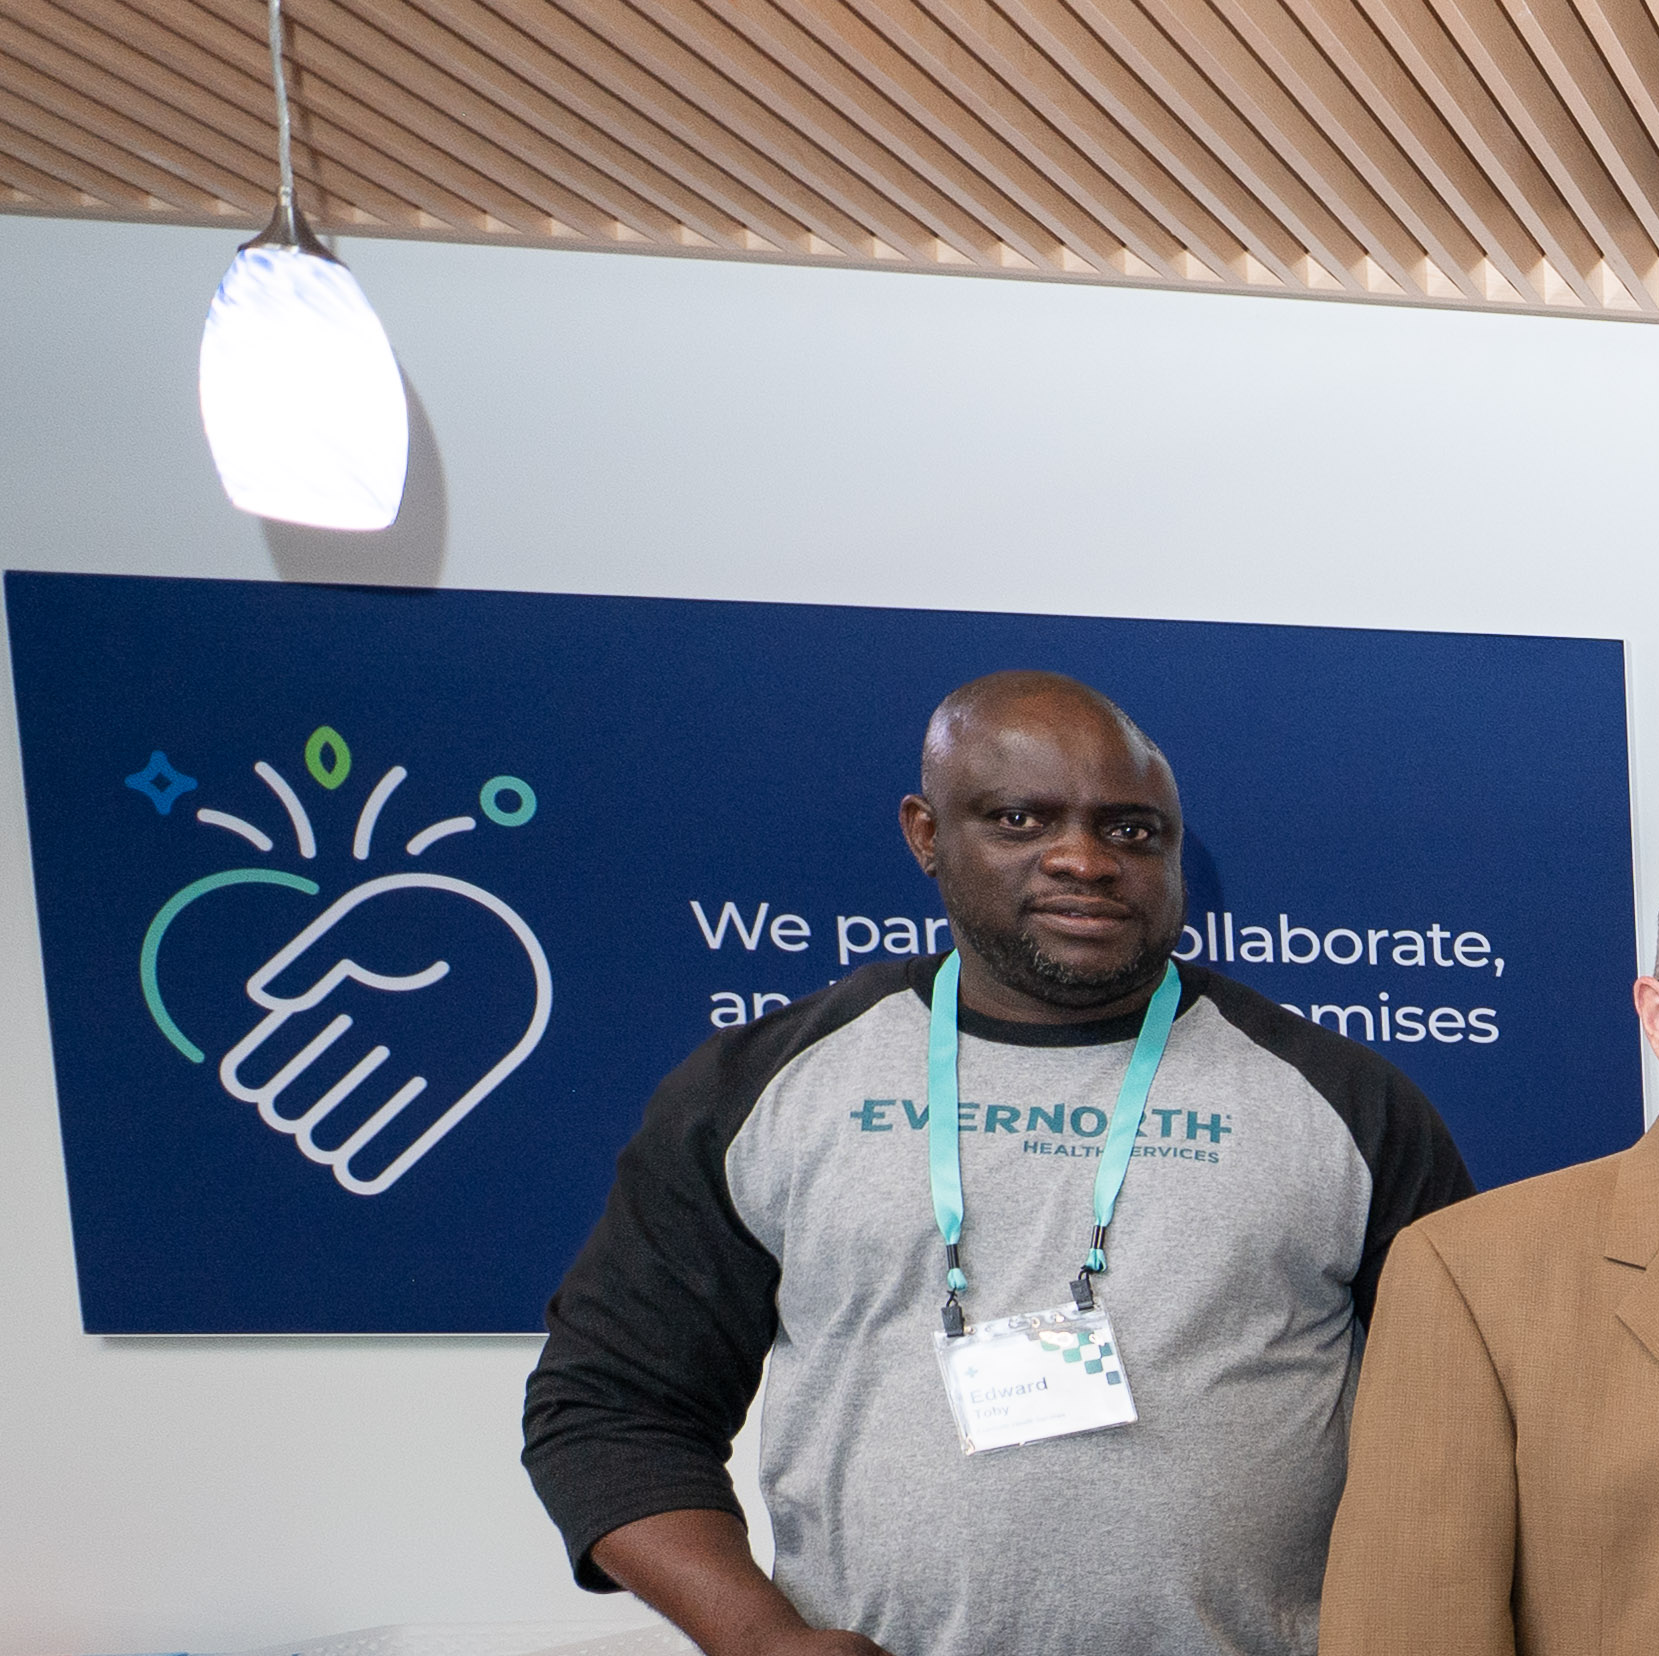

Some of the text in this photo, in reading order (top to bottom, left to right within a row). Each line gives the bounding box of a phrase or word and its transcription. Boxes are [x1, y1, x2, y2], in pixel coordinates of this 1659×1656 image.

[690, 900, 812, 952] We
[1171, 912, 1504, 977] ollaborate,
[850, 1099, 1231, 1143] EVERNOTH
[1129, 1146, 1219, 1164] ERVICES
[970, 1376, 1048, 1404] Edward
